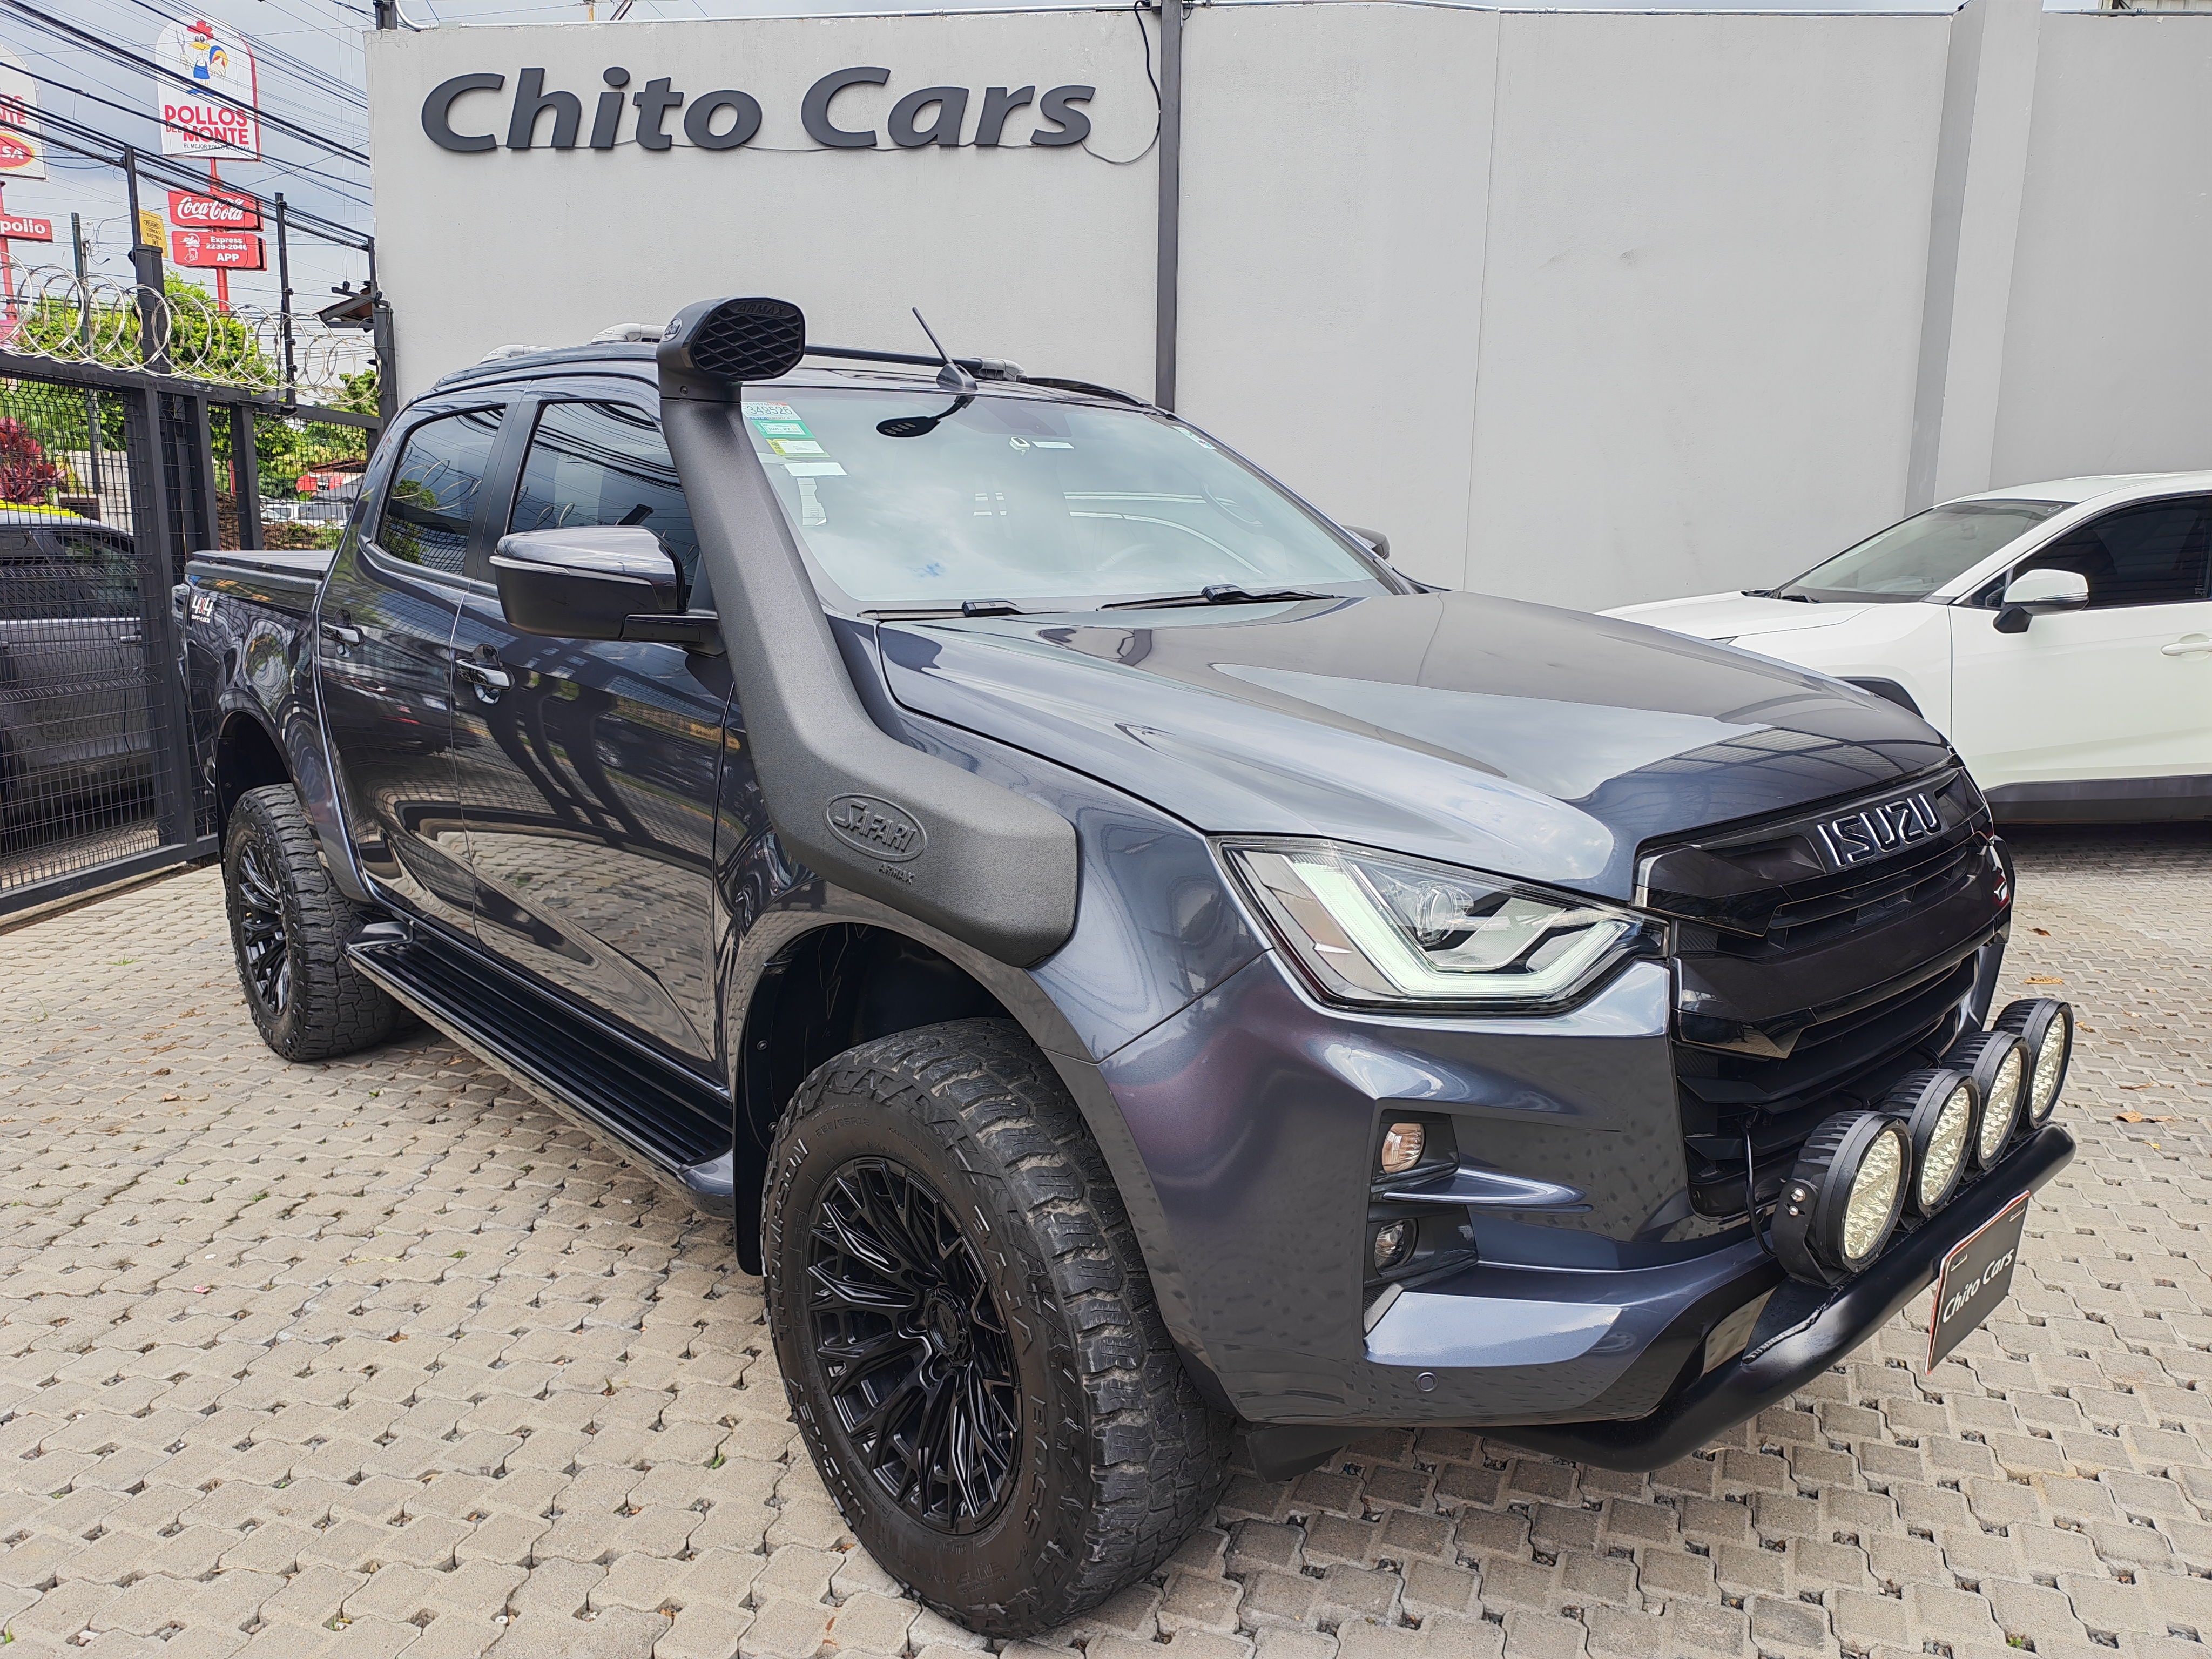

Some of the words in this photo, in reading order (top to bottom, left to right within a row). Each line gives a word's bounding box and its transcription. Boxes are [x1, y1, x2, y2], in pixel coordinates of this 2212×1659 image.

[165, 105, 247, 127] POLLOS
[422, 66, 763, 152] Chito
[801, 65, 1097, 150] Cars
[183, 125, 249, 145] MONTE
[177, 197, 245, 221] Coca-Cola
[210, 236, 242, 244] Express
[217, 253, 239, 262] APP
[736, 303, 786, 316] ARMAX
[746, 406, 793, 415] 349526
[832, 797, 917, 852] SAFARI
[1817, 792, 1942, 867] ISUZU
[879, 862, 915, 885] ARMAX
[770, 1137, 810, 1341] THOMPSON
[1943, 1278, 1980, 1324] Chito
[1982, 1247, 2015, 1286] Cars
[972, 1204, 1034, 1356] BAJA
[1024, 1395, 1048, 1539] BOSS
